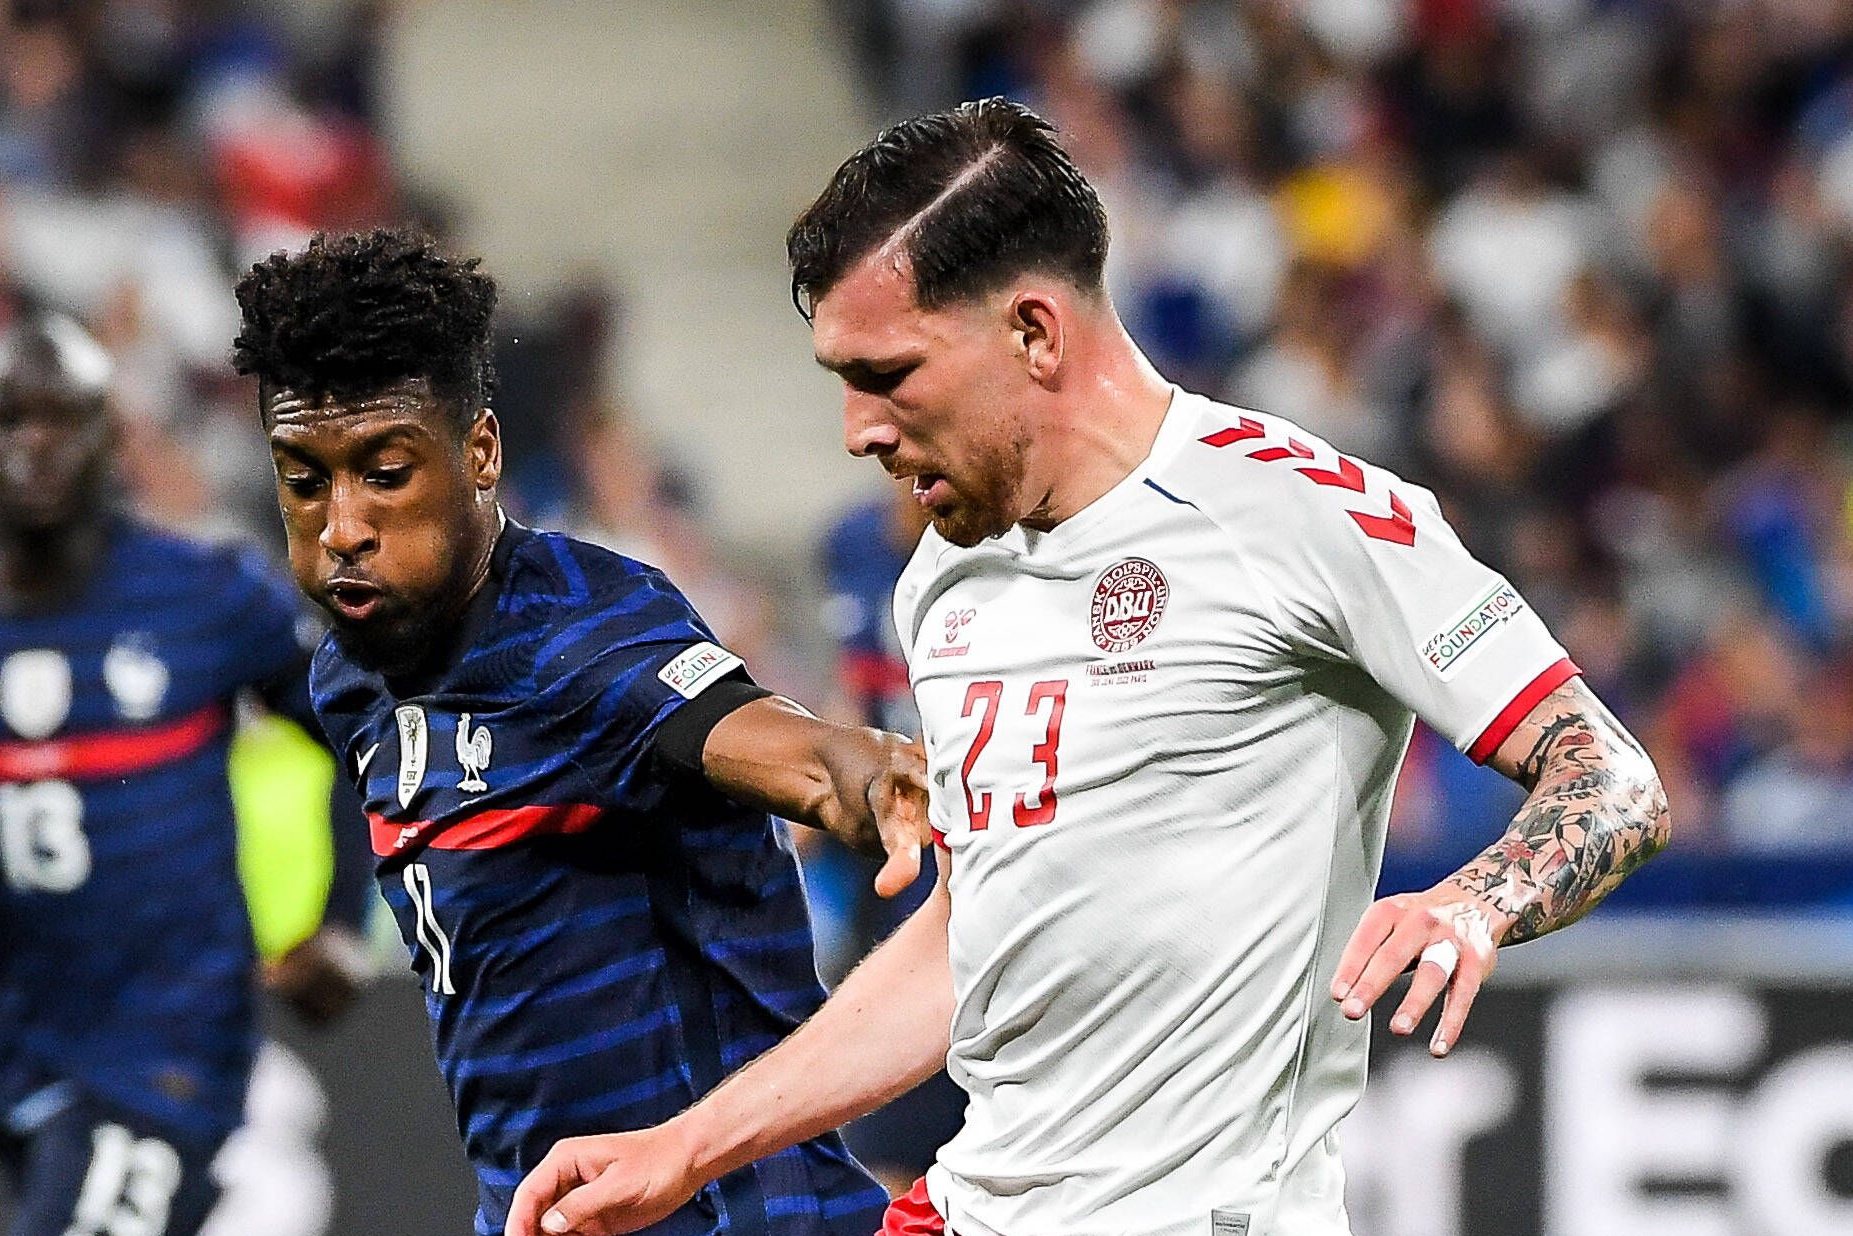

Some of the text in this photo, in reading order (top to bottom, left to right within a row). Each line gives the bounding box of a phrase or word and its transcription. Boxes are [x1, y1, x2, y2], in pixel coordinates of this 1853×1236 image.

[1103, 591, 1153, 623] DBU
[1429, 588, 1516, 668] FOUNDATION
[960, 679, 1069, 833] 23
[403, 863, 457, 995] 11
